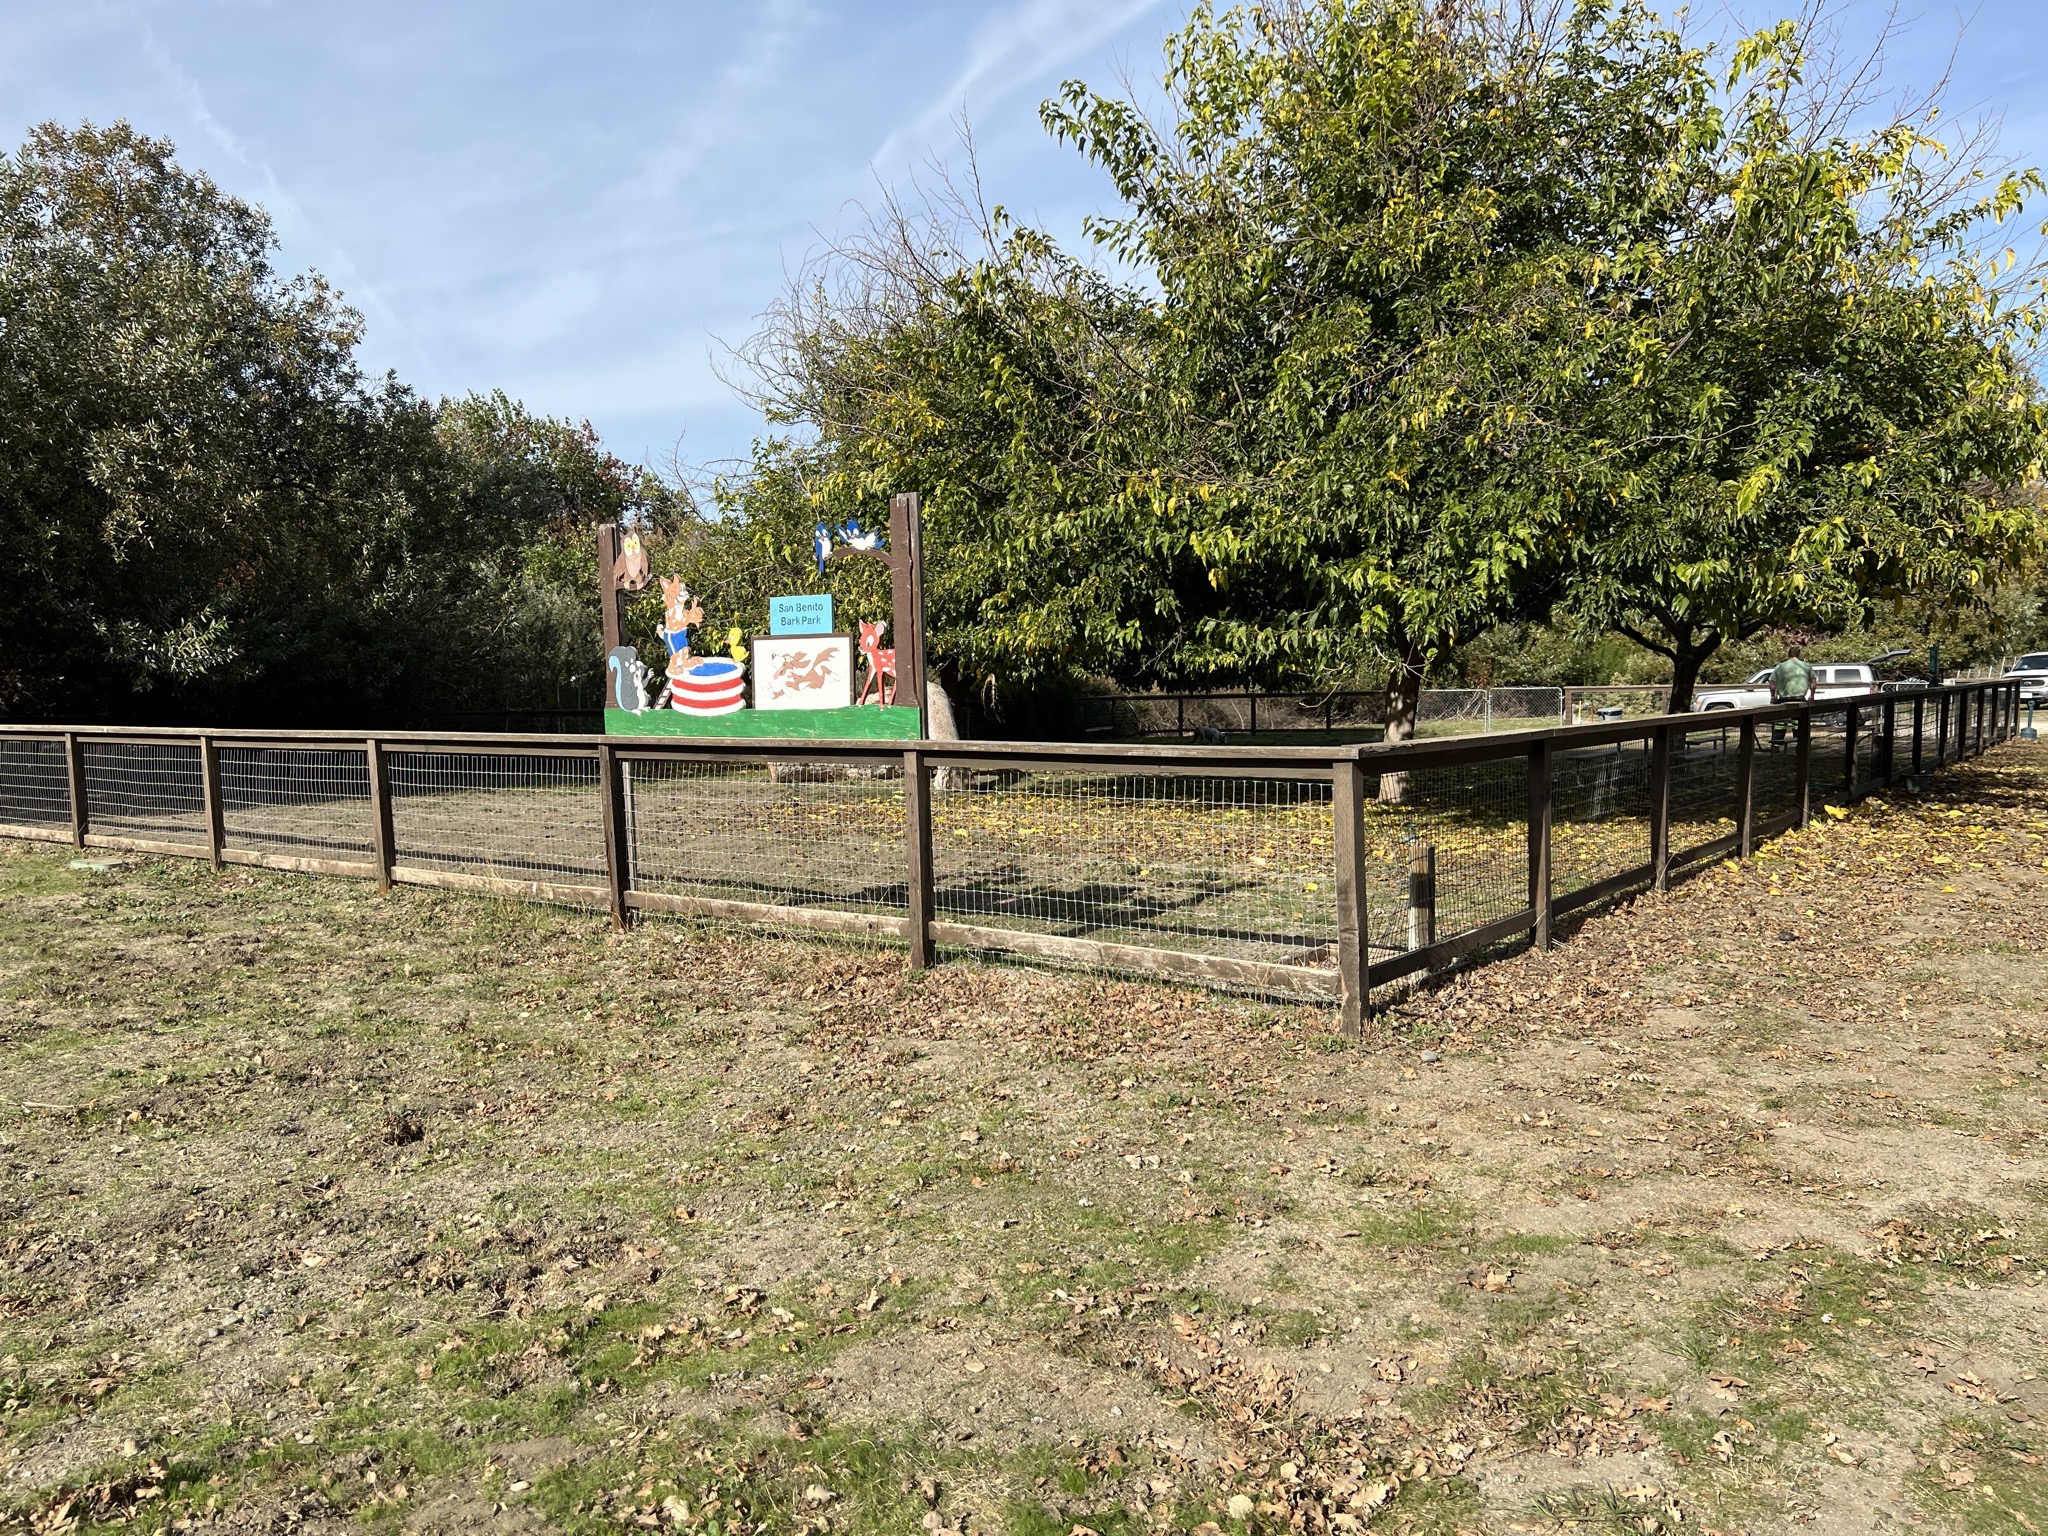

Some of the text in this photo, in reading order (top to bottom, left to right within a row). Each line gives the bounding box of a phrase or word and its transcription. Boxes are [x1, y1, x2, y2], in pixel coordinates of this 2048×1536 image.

[779, 602, 824, 613] San Benito
[780, 615, 821, 626] Bark Park
